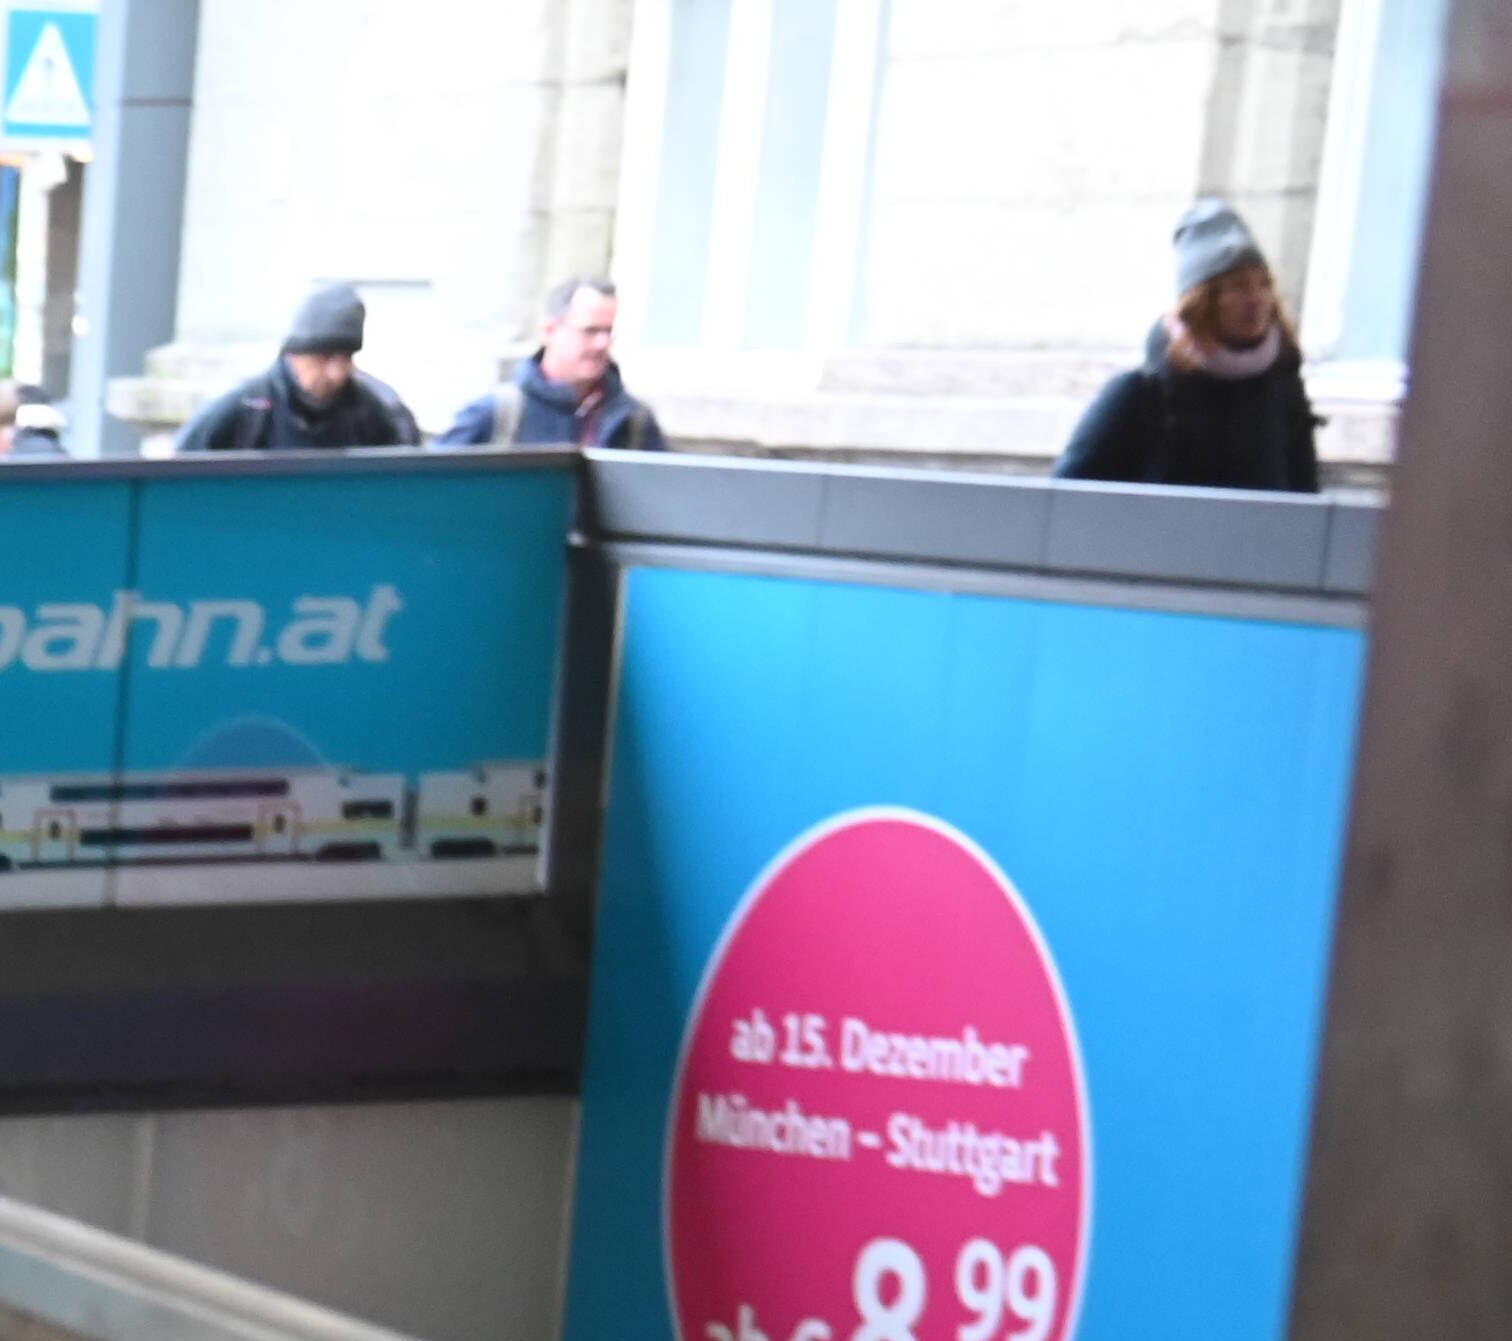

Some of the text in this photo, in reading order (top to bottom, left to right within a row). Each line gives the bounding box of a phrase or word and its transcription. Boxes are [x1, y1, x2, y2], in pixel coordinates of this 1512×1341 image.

[730, 1008, 1029, 1088] ab 15. Dezember
[695, 1092, 852, 1160] München
[886, 1111, 1061, 1199] Stuttgart
